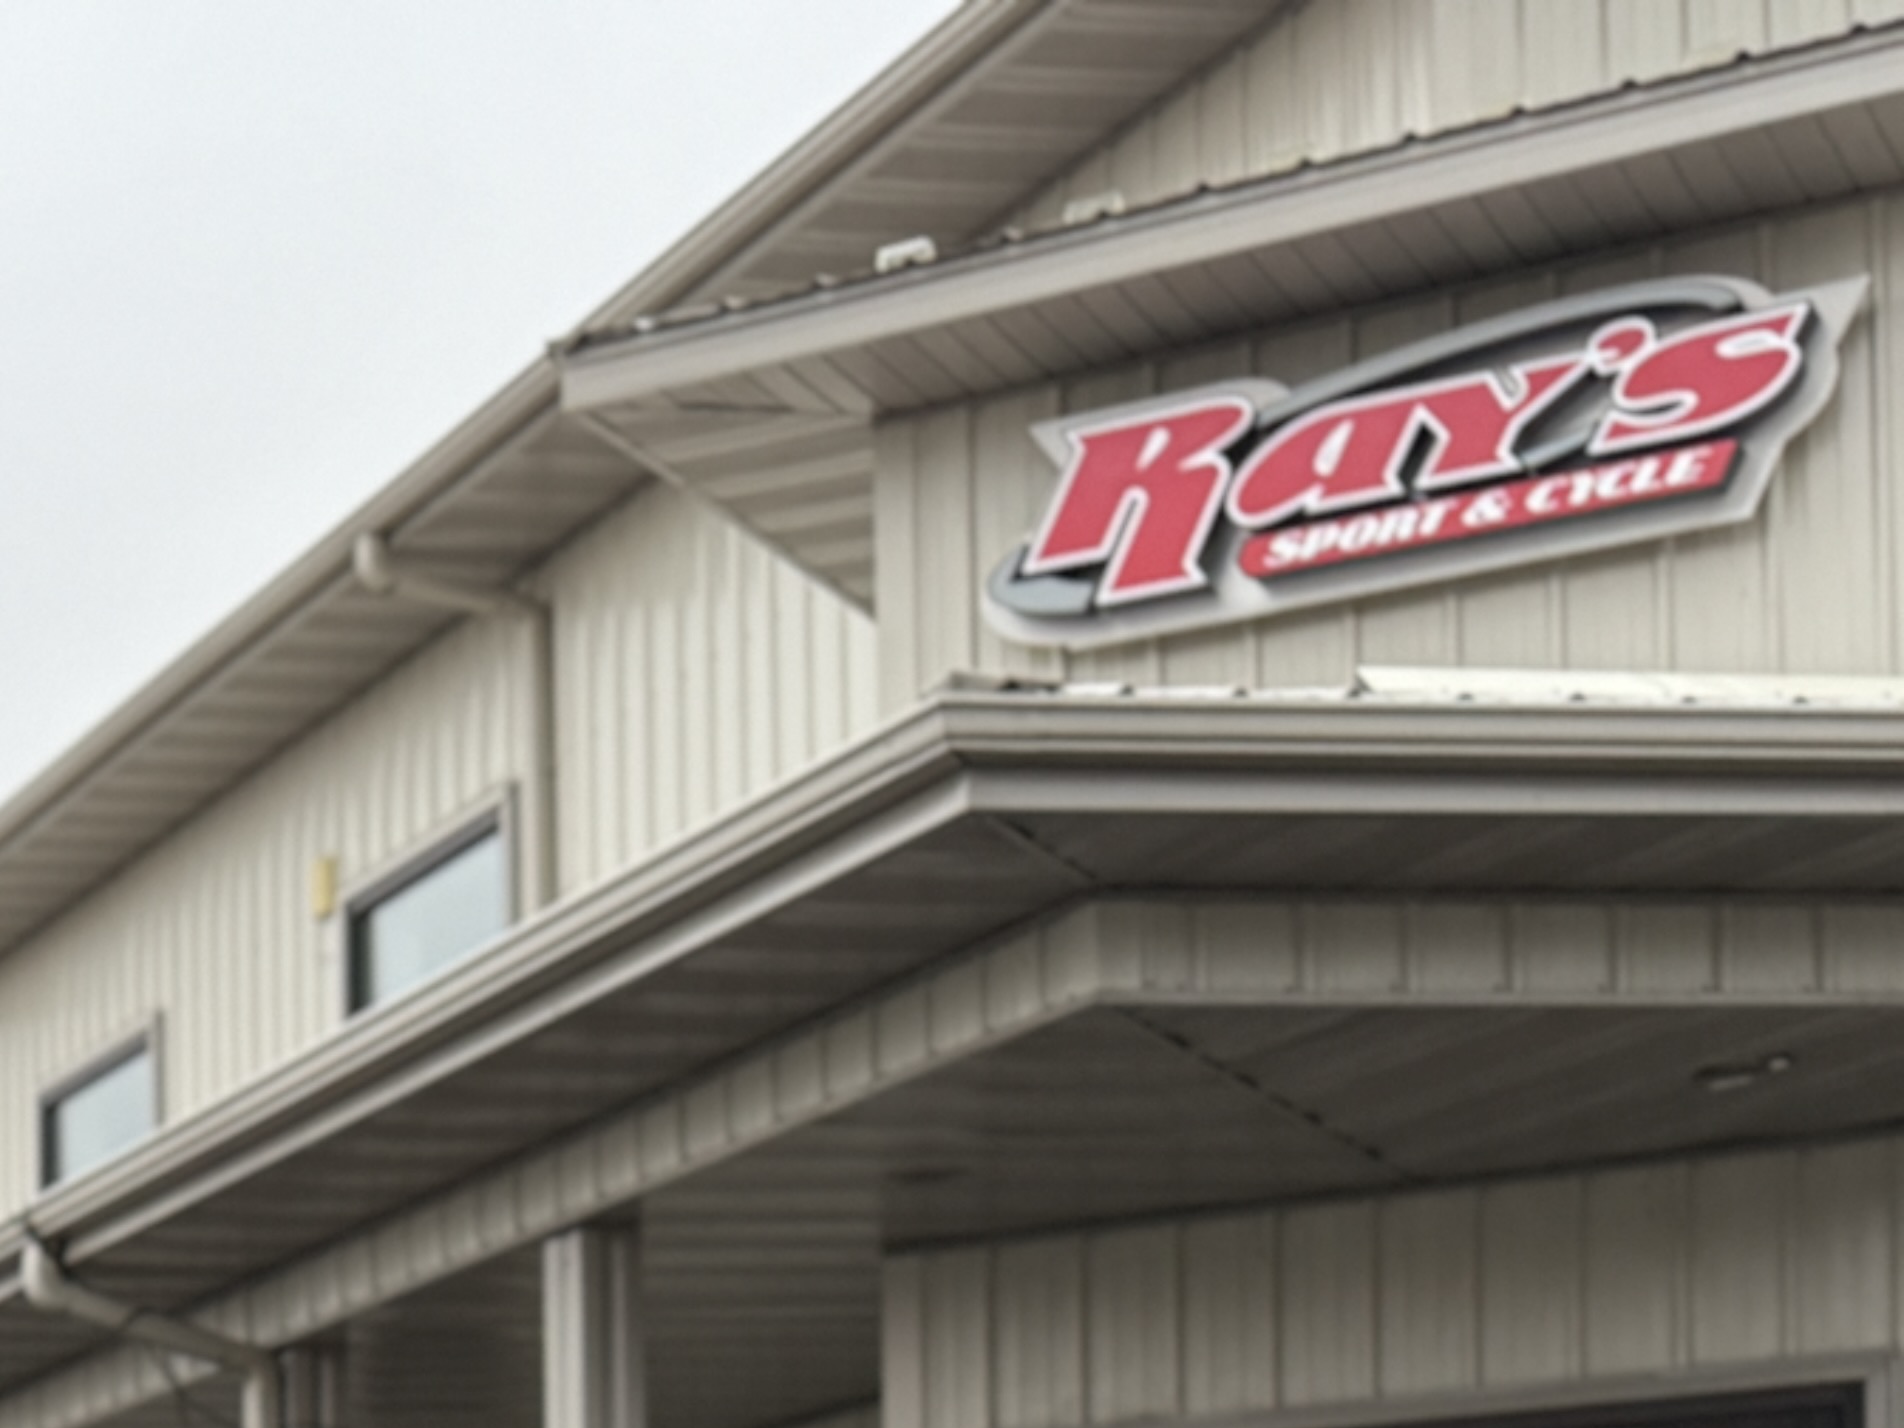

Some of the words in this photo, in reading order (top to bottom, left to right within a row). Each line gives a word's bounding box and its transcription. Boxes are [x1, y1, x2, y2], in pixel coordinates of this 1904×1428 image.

[1262, 498, 1448, 569] SPORT
[1461, 490, 1514, 527] &
[1525, 447, 1713, 513] CYCLE
